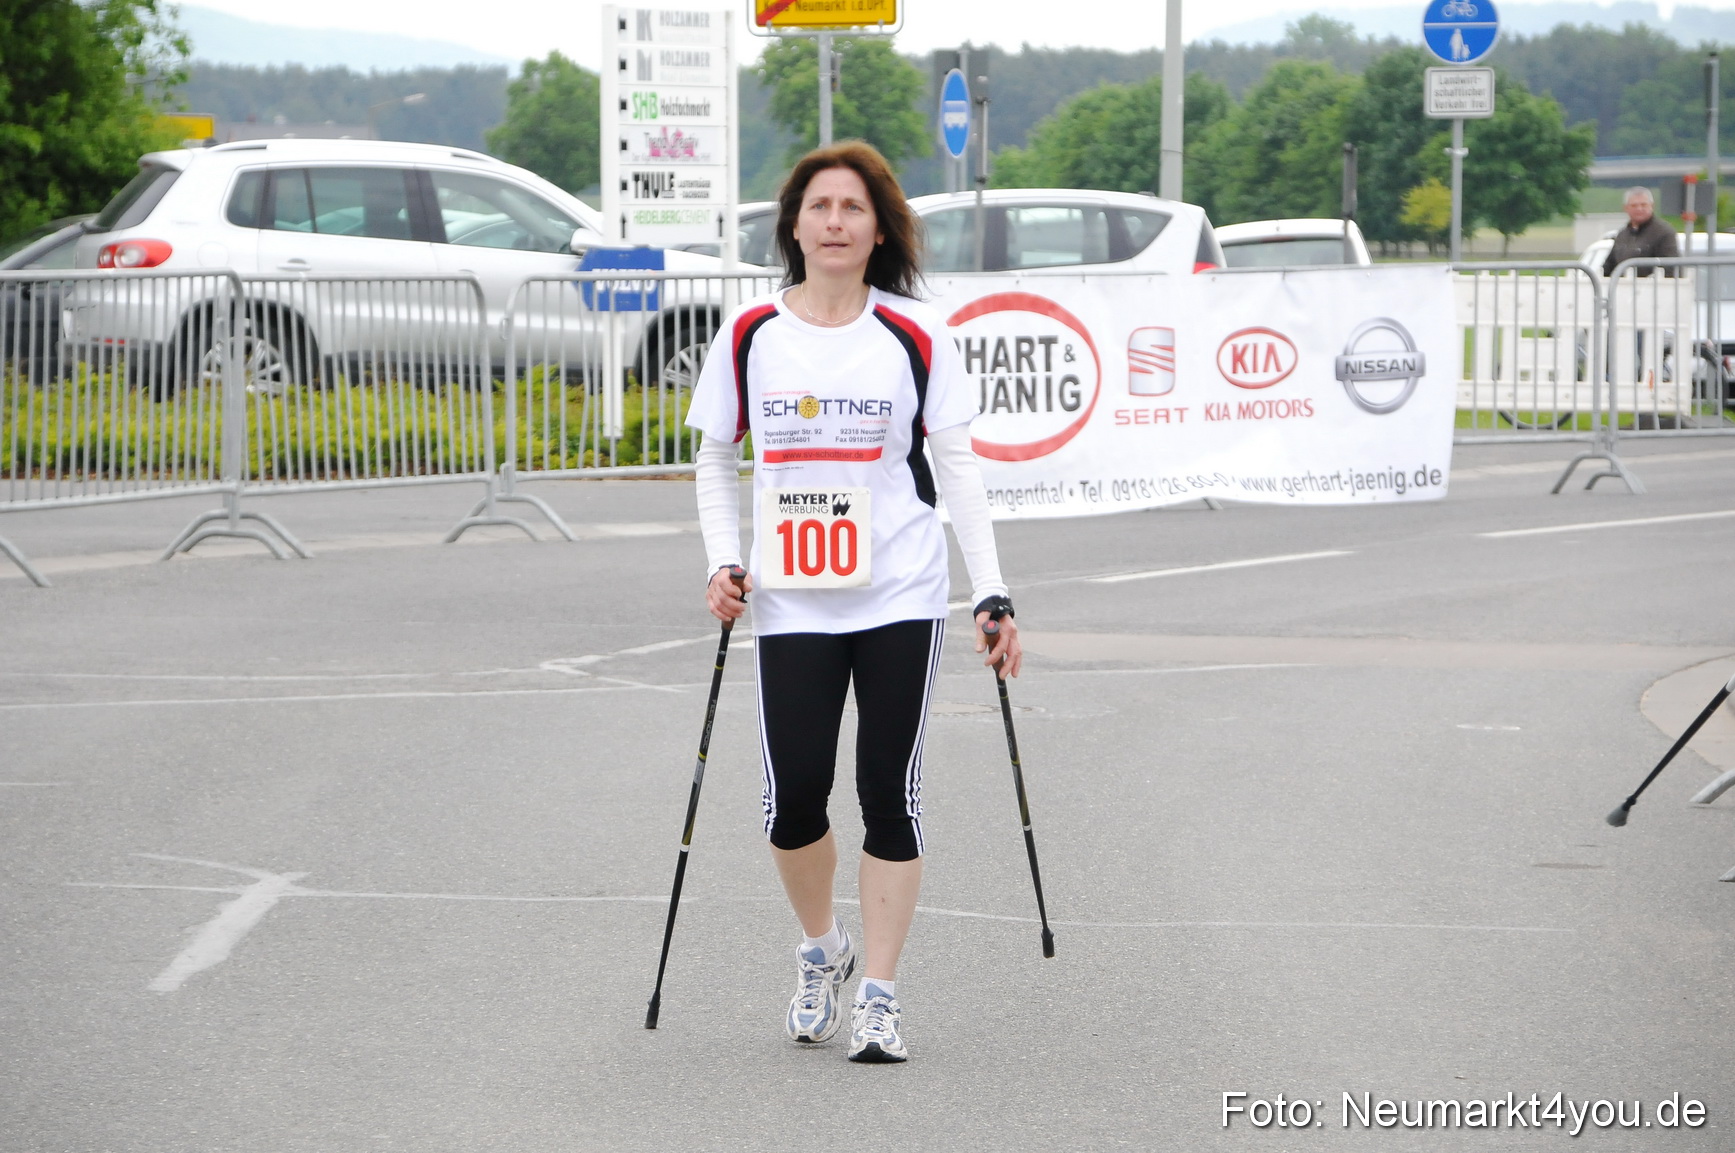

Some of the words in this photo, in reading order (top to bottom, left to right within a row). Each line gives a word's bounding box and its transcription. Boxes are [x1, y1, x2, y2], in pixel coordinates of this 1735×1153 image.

[796, 0, 846, 11] Neumarkt
[632, 91, 659, 120] SHB
[660, 96, 710, 117] Holzfachmarkt
[632, 171, 675, 199] THULE
[633, 209, 711, 225] HEIDELBERGCEMENT
[953, 335, 1059, 375] HART
[1063, 343, 1077, 363] &
[1230, 342, 1283, 375] KIA
[1344, 357, 1418, 375] NISSAN
[1114, 407, 1189, 426] SEAT
[1204, 402, 1232, 421] KIA
[1236, 397, 1315, 421] MOTORS
[782, 450, 864, 460] www.sv-schottner.de
[985, 480, 1064, 512] engenthal
[1079, 480, 1109, 504] Tel.
[1111, 477, 1187, 502] 09181/26
[1239, 464, 1443, 498] www.gerhart-jaenig.de
[778, 493, 828, 505] MEYER
[778, 505, 829, 514] WERBUNG
[776, 518, 858, 577] 100
